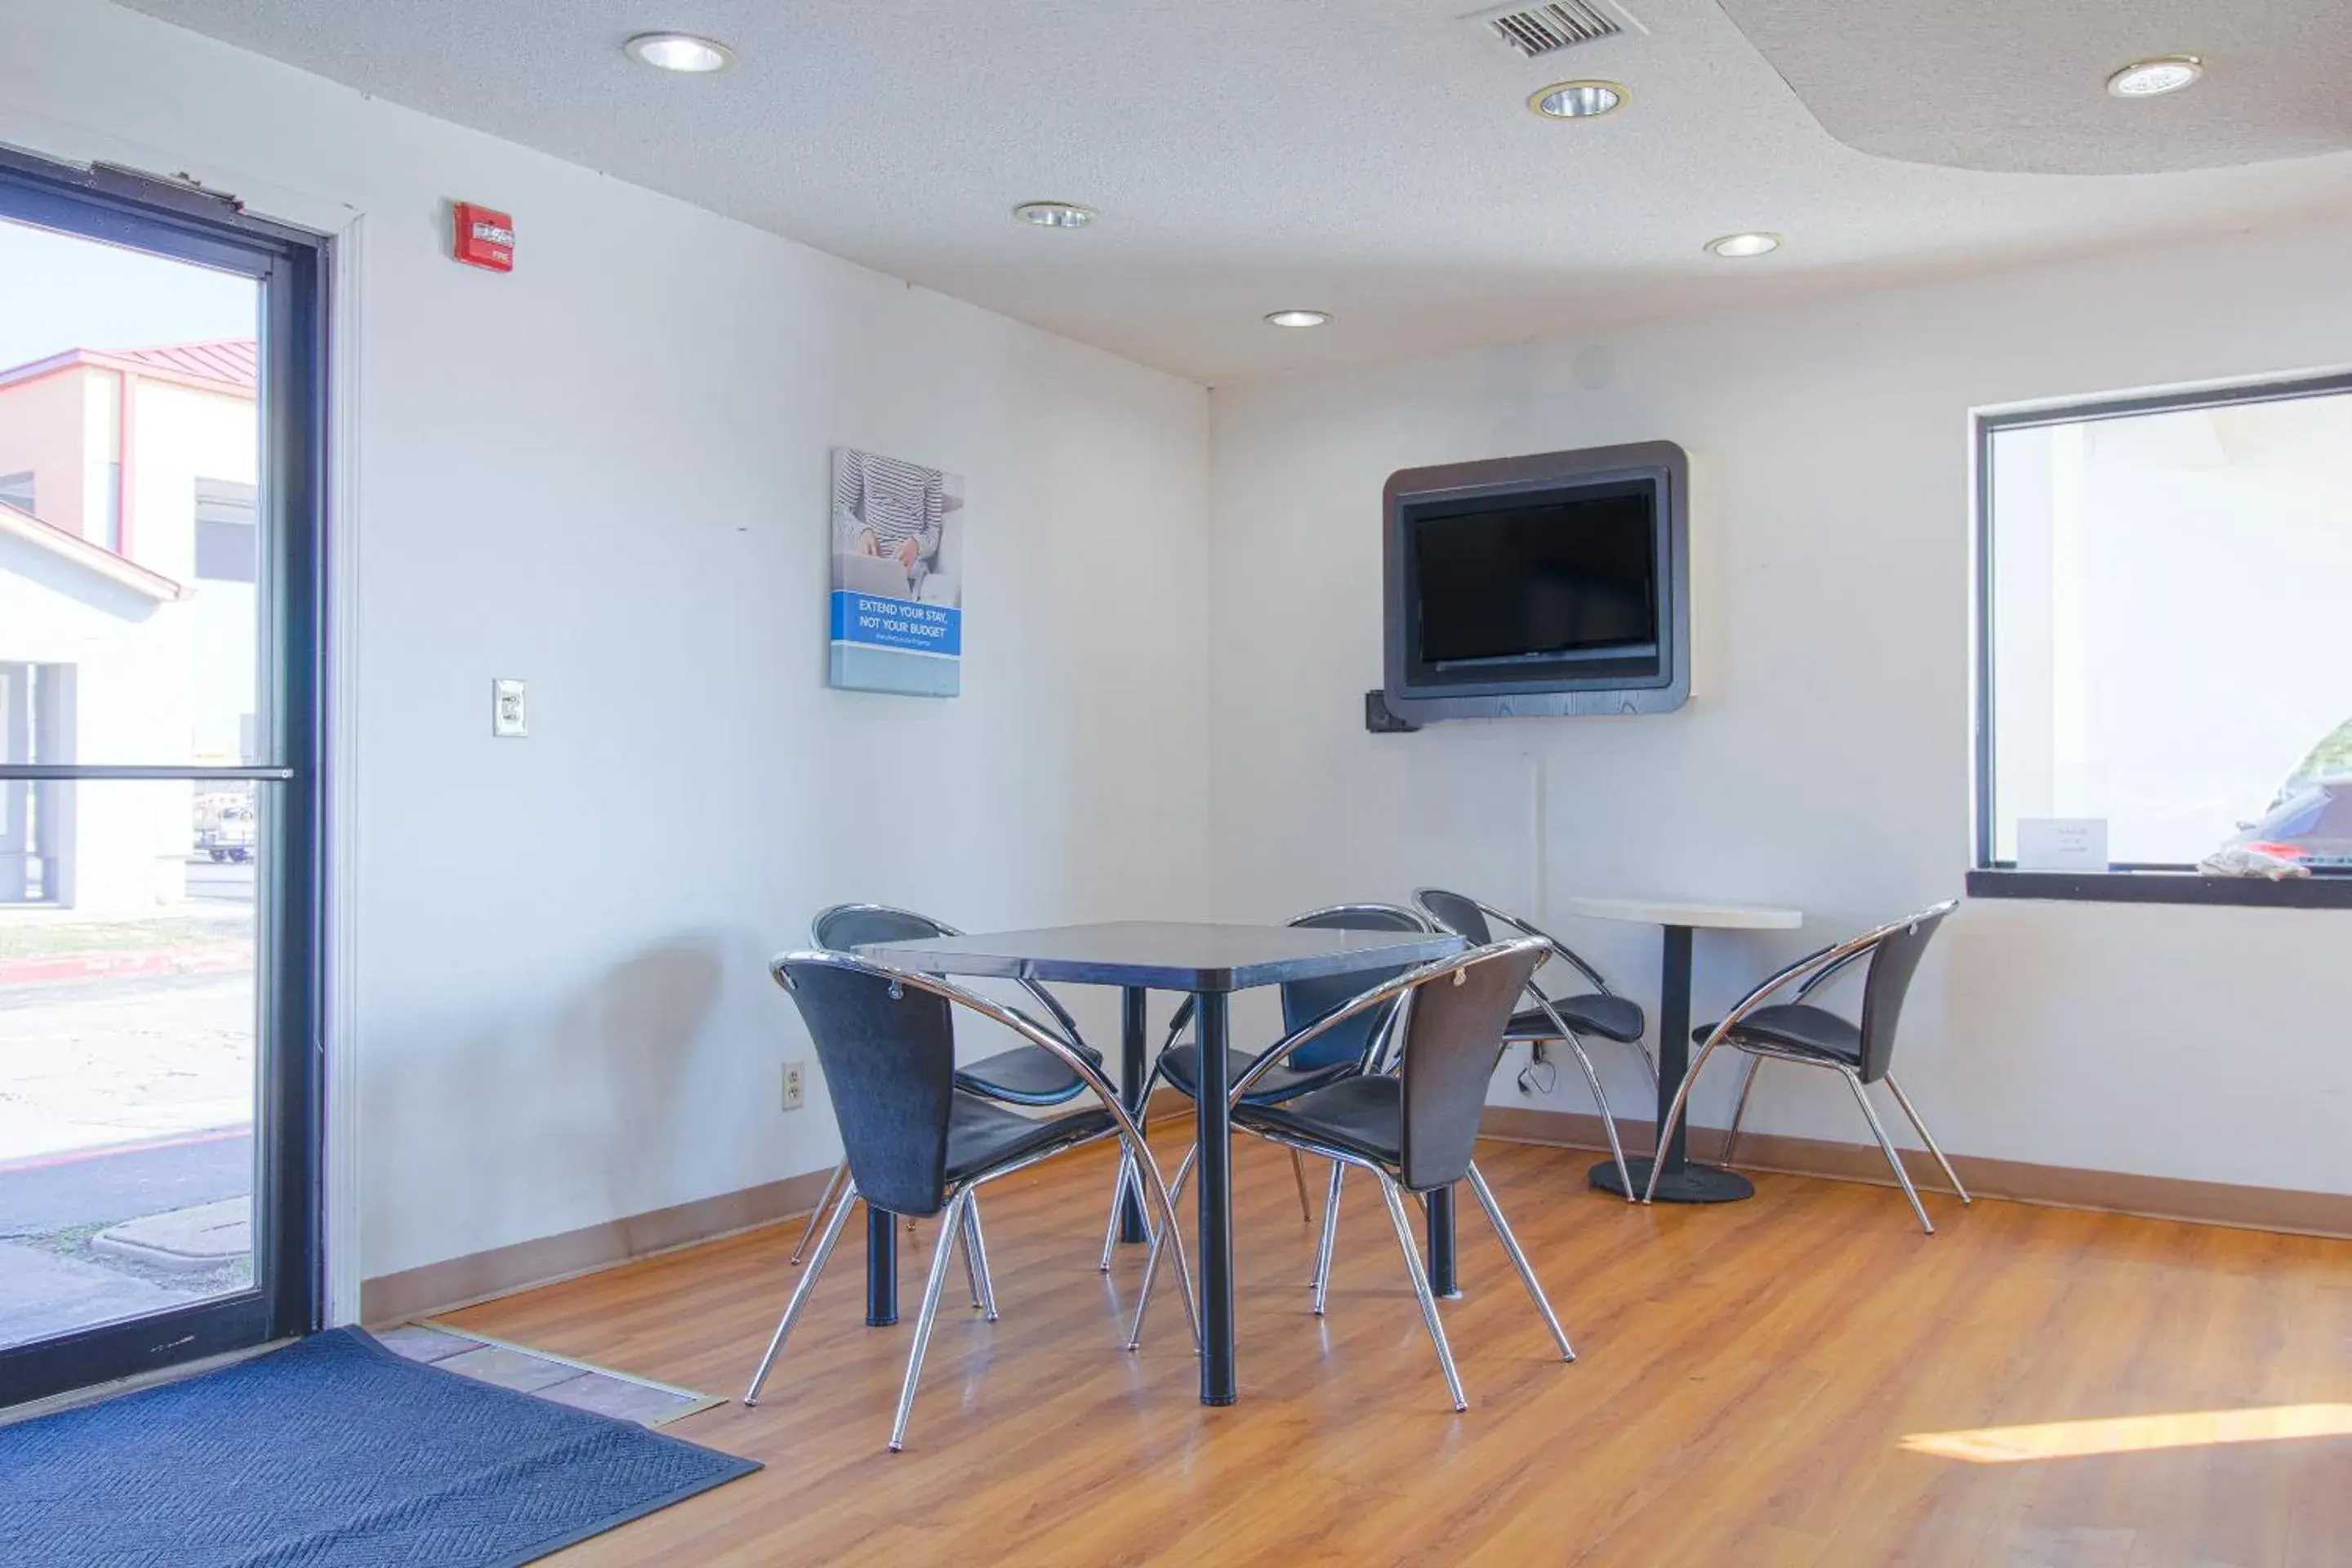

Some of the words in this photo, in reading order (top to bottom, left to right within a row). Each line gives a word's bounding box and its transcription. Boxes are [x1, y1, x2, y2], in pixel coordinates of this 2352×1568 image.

[859, 599, 897, 616] EXTEND
[900, 606, 924, 618] YOUR
[926, 611, 947, 625] STAY,
[860, 616, 880, 629] NOT
[883, 619, 909, 632] YOUR
[911, 622, 947, 639] BUDGET
